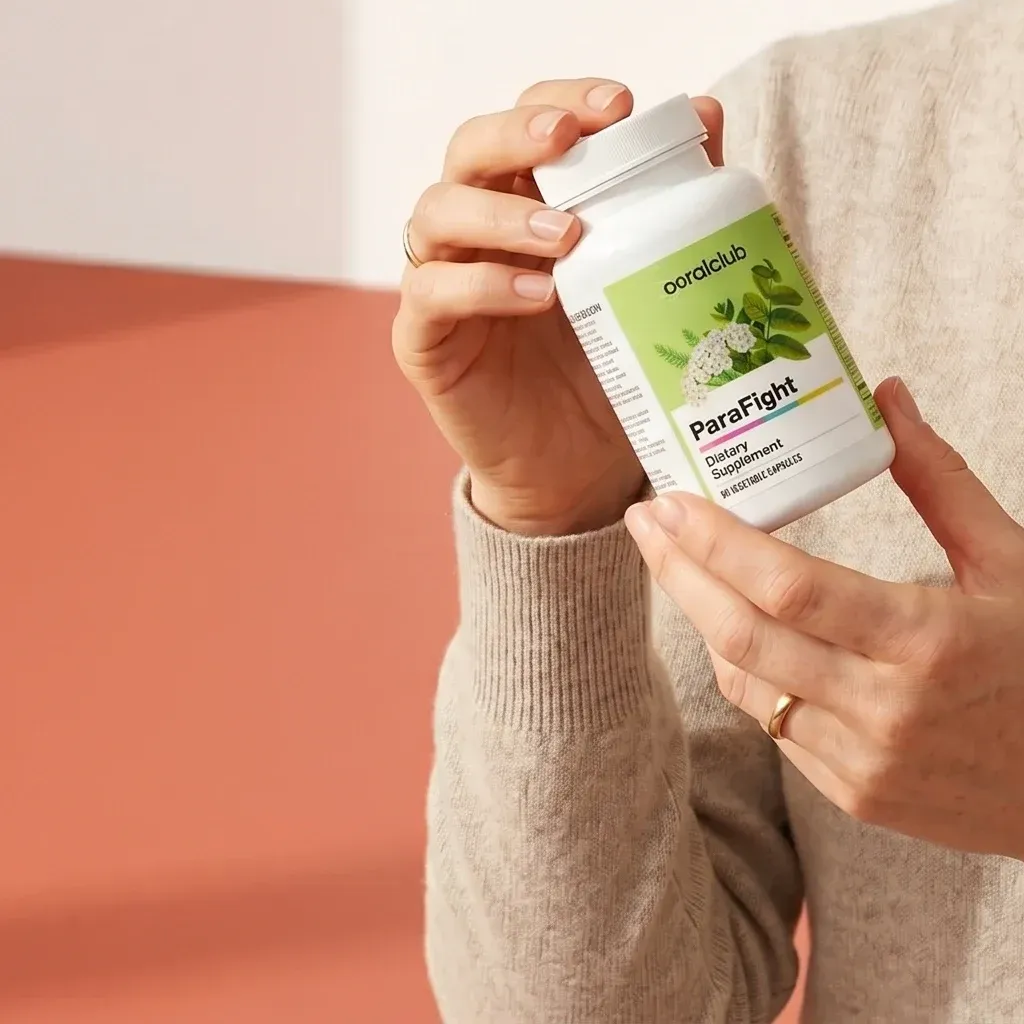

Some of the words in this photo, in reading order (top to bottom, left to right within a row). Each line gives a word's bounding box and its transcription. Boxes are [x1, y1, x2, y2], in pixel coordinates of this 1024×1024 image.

[663, 244, 747, 295] ooralclub
[689, 376, 798, 441] ParaFight
[711, 438, 784, 479] Supplement
